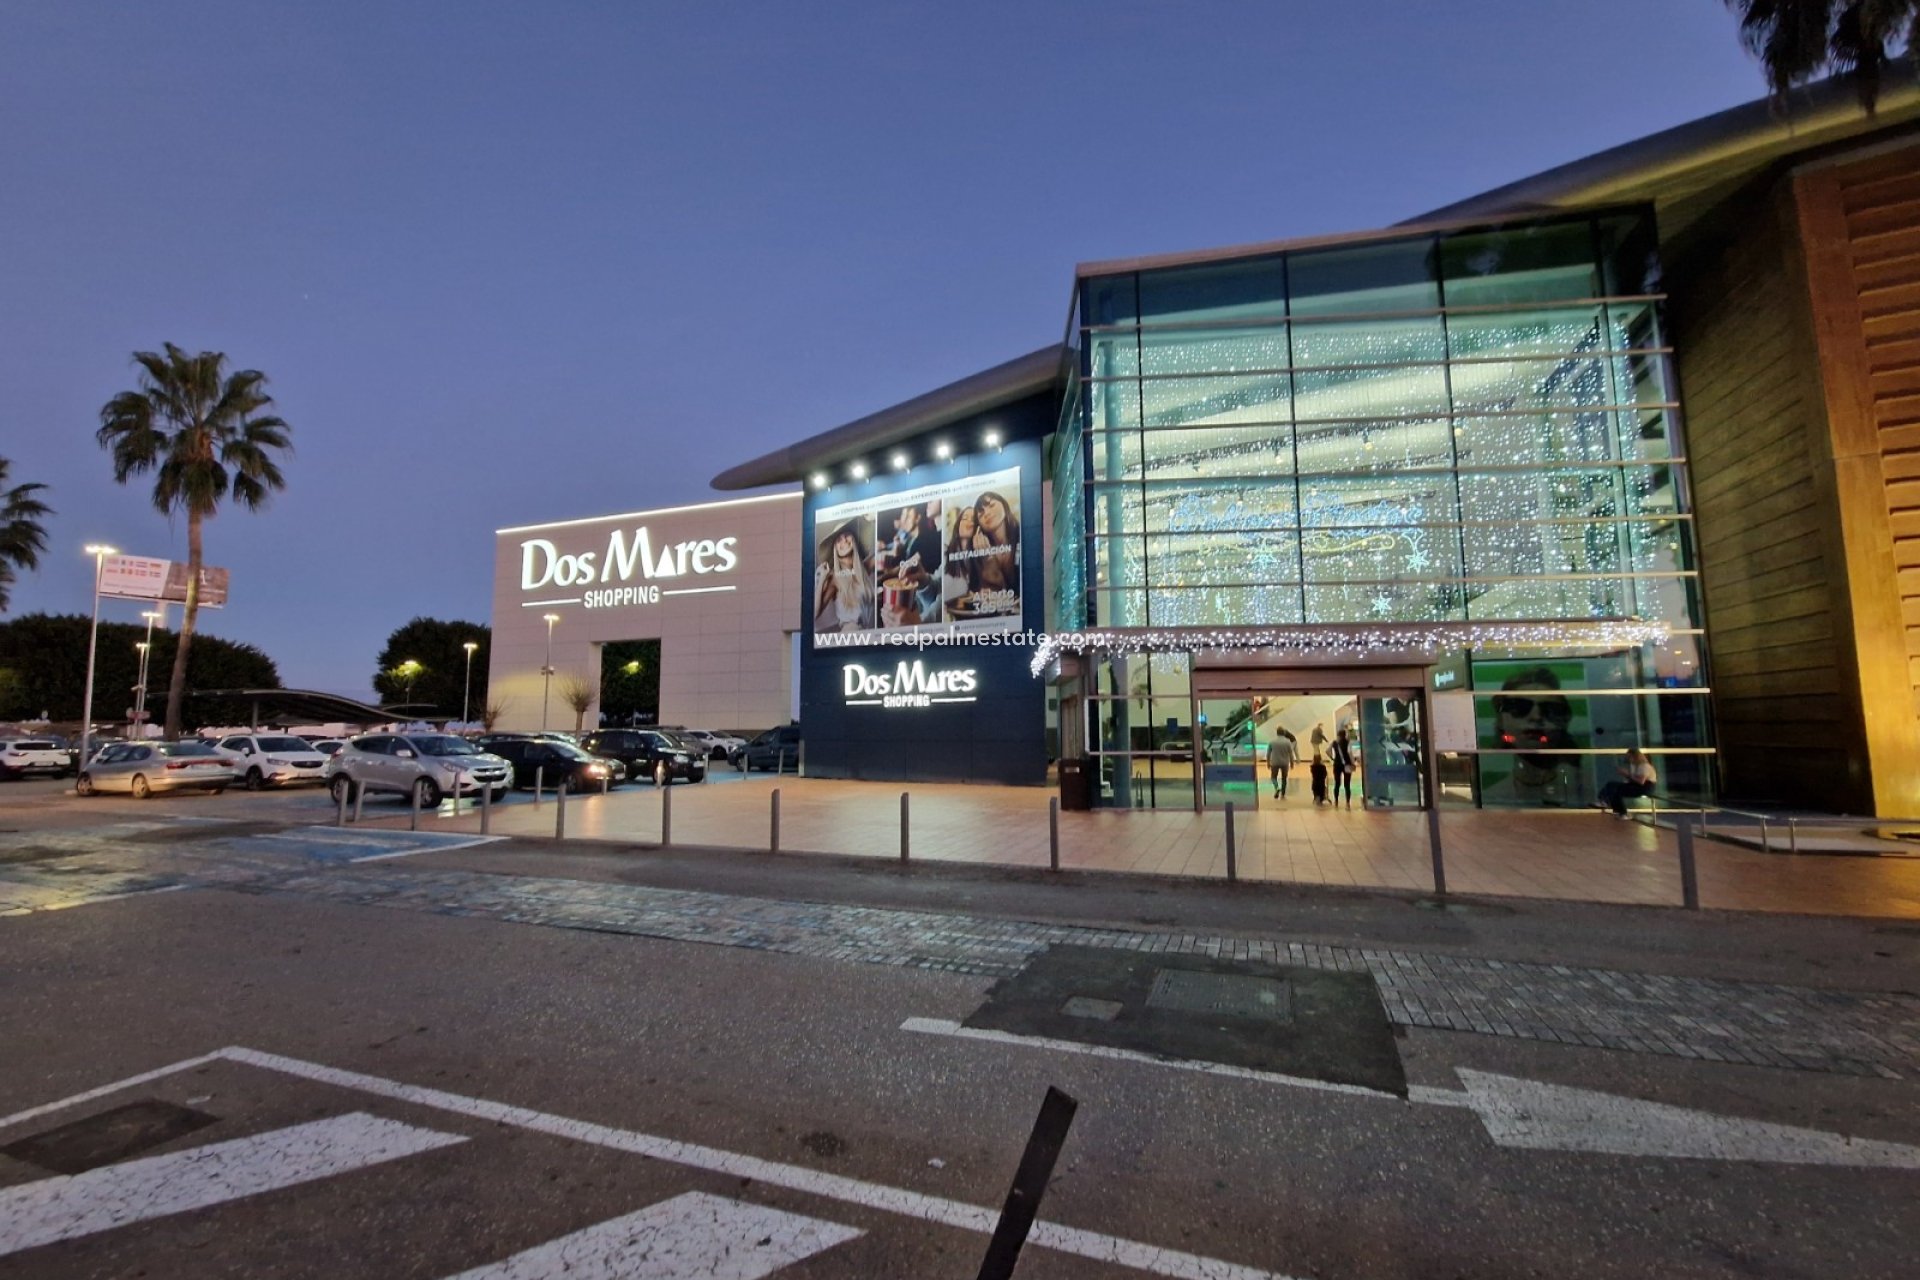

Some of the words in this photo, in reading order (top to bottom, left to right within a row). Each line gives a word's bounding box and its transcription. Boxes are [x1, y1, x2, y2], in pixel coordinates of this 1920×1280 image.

[520, 538, 597, 591] Dos
[600, 526, 738, 582] Mares
[948, 544, 1012, 562] RESTAURACIÓN
[583, 585, 660, 609] SHOPPING
[972, 600, 997, 615] 365
[842, 663, 890, 696] Dos
[893, 659, 977, 694] Mares
[882, 694, 931, 708] SHOPPING
